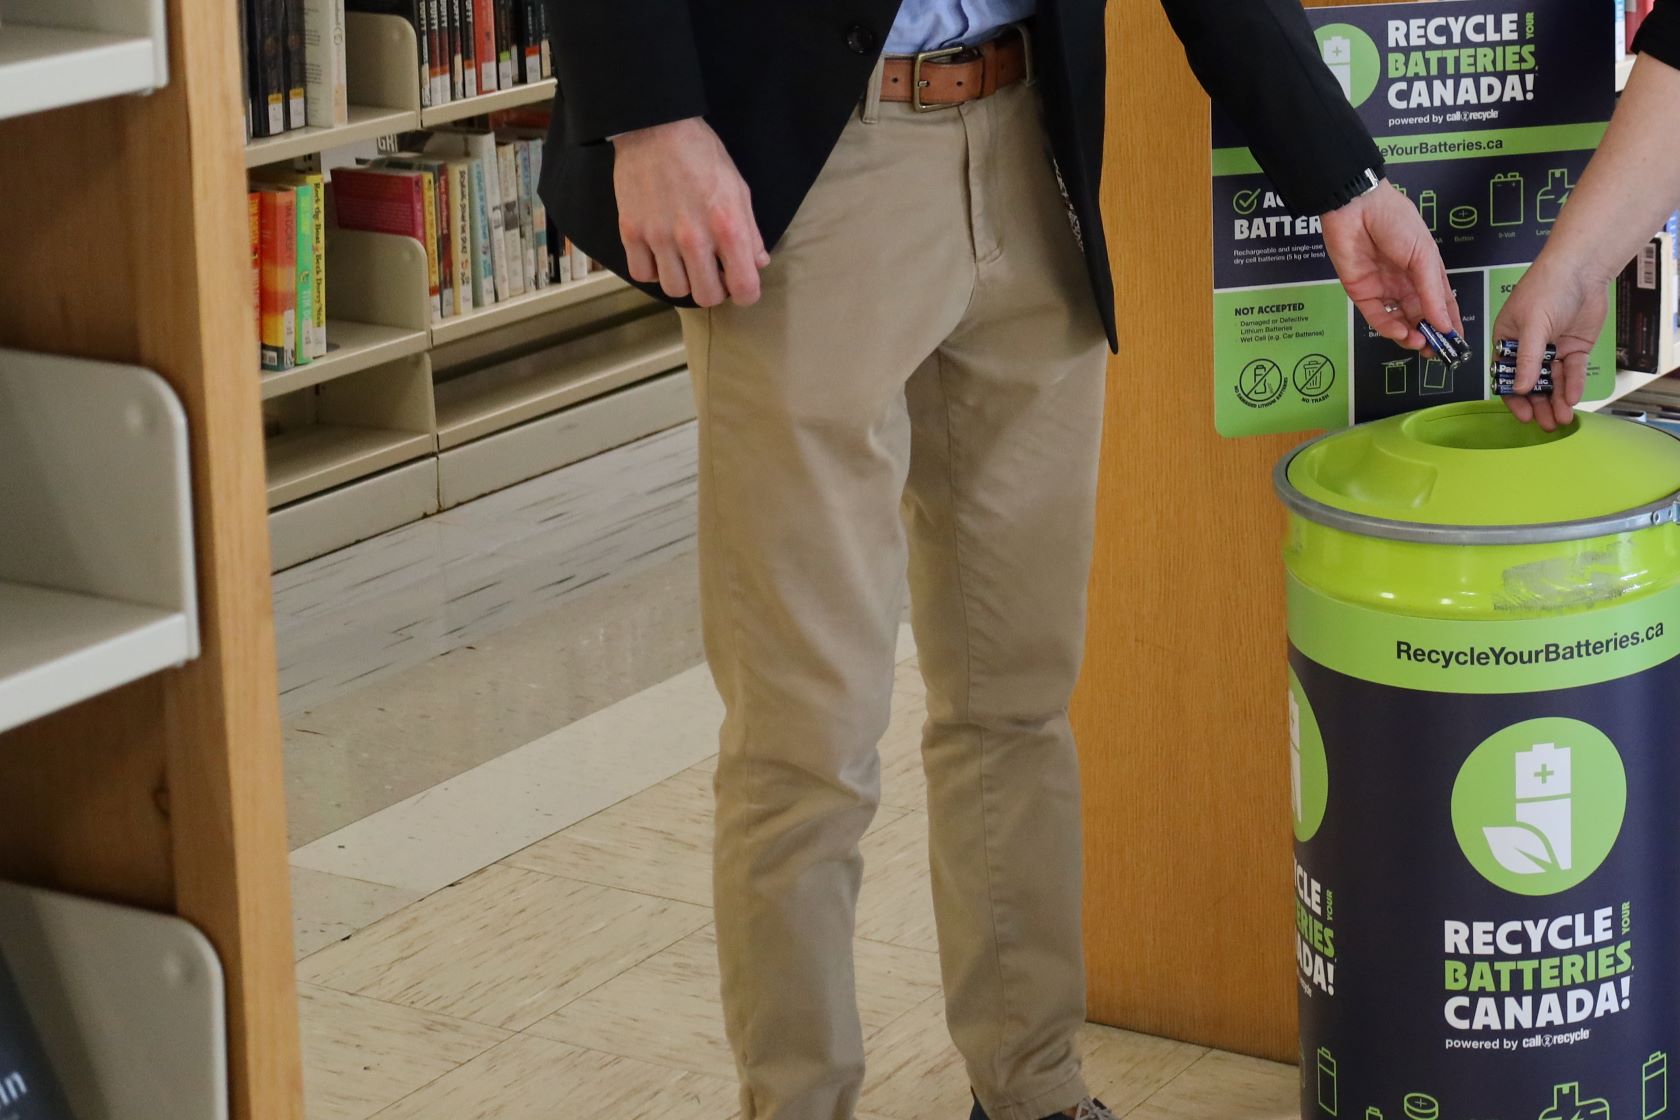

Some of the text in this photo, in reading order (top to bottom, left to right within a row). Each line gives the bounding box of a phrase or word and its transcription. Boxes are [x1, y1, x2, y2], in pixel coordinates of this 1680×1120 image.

[1387, 12, 1519, 48] RECYCLE
[1525, 11, 1535, 40] YOUR
[1387, 44, 1536, 79] BATTERIES
[1387, 73, 1535, 110] CANADA!
[1388, 114, 1430, 127] powered
[1431, 113, 1444, 124] by
[1233, 247, 1277, 257] Rechargeable
[1291, 243, 1323, 253] single-use
[1233, 257, 1244, 265] dry
[1245, 256, 1257, 264] cell
[1258, 254, 1286, 263] batteries
[1234, 302, 1305, 317] NOT ACCEPTED
[1240, 318, 1270, 328] Damaged
[1280, 316, 1309, 324] Defective
[1240, 325, 1293, 335] Lithium Batteries
[1295, 330, 1325, 339] Batteries)
[1311, 393, 1330, 404] TRASH
[1395, 621, 1665, 669] RecycleYourBatteries.ca
[1620, 900, 1631, 936] YOUR
[1444, 906, 1613, 955] RECYCLE
[1444, 940, 1632, 992] BATTERIES
[1443, 975, 1631, 1030] CANADA!
[1445, 1038, 1500, 1049] powered
[1503, 1038, 1518, 1051] by
